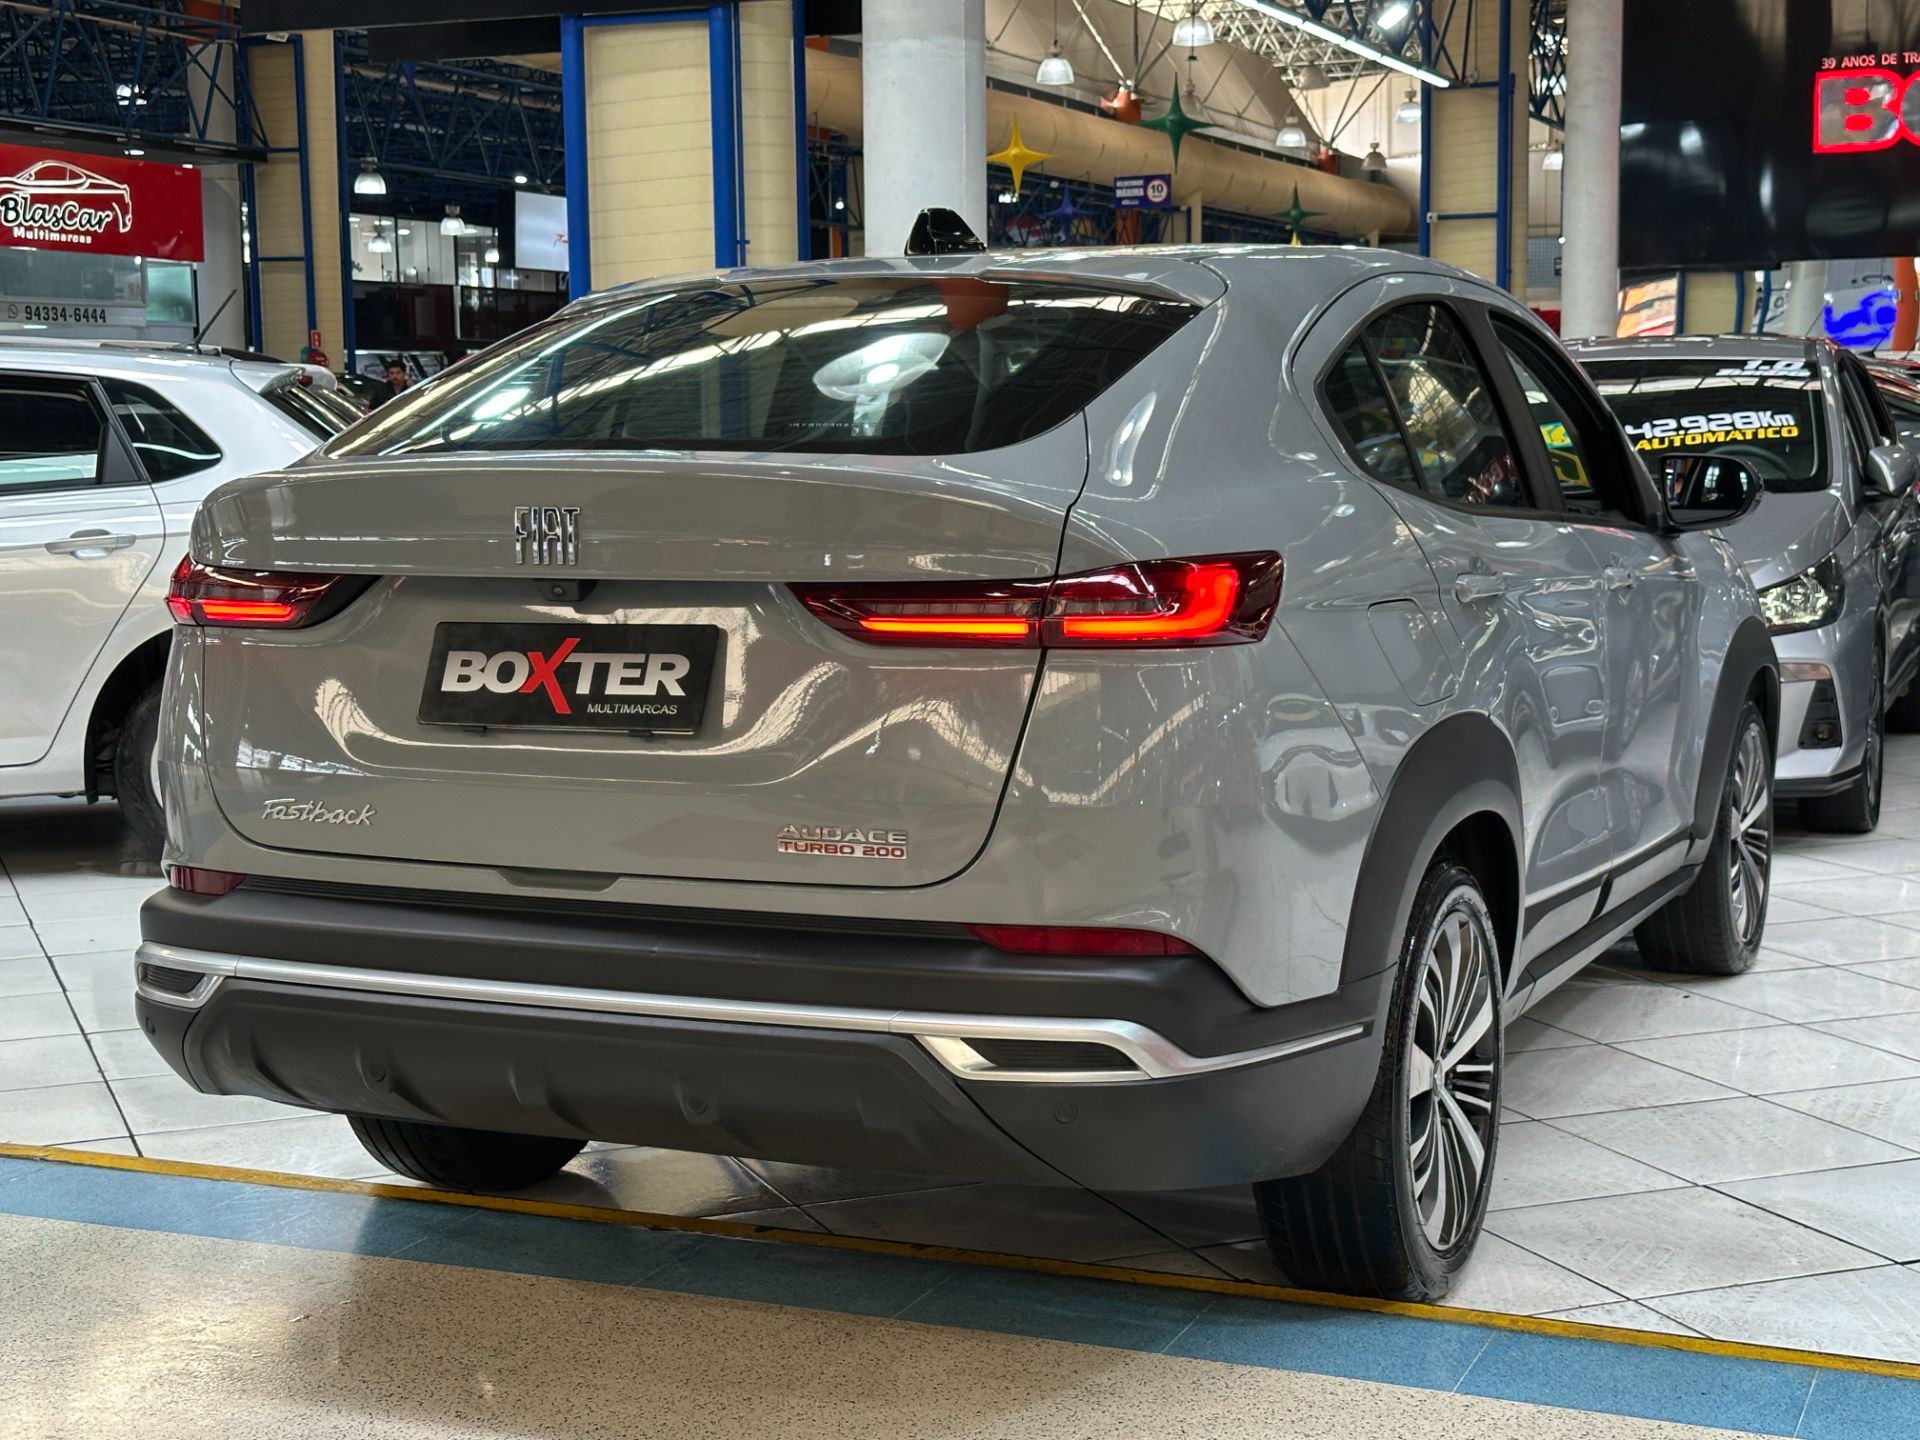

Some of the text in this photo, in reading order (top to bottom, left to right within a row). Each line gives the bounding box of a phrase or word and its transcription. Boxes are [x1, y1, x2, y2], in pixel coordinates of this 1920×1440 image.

[1821, 58, 1836, 69] 39
[1841, 54, 1875, 68] ANOS
[1881, 53, 1897, 66] DE
[0, 194, 113, 233] BlasCar
[13, 227, 92, 244] Multimarcas
[25, 305, 106, 323] 94334-6444
[1635, 426, 1799, 451] AUTOMATICO
[514, 506, 580, 565] FIAT
[440, 638, 691, 714] BOXTER
[586, 703, 678, 715] MULTIMARCAS
[261, 798, 376, 825] Fastback
[777, 824, 907, 844] AUDACE
[779, 840, 905, 858] TURBO 200
